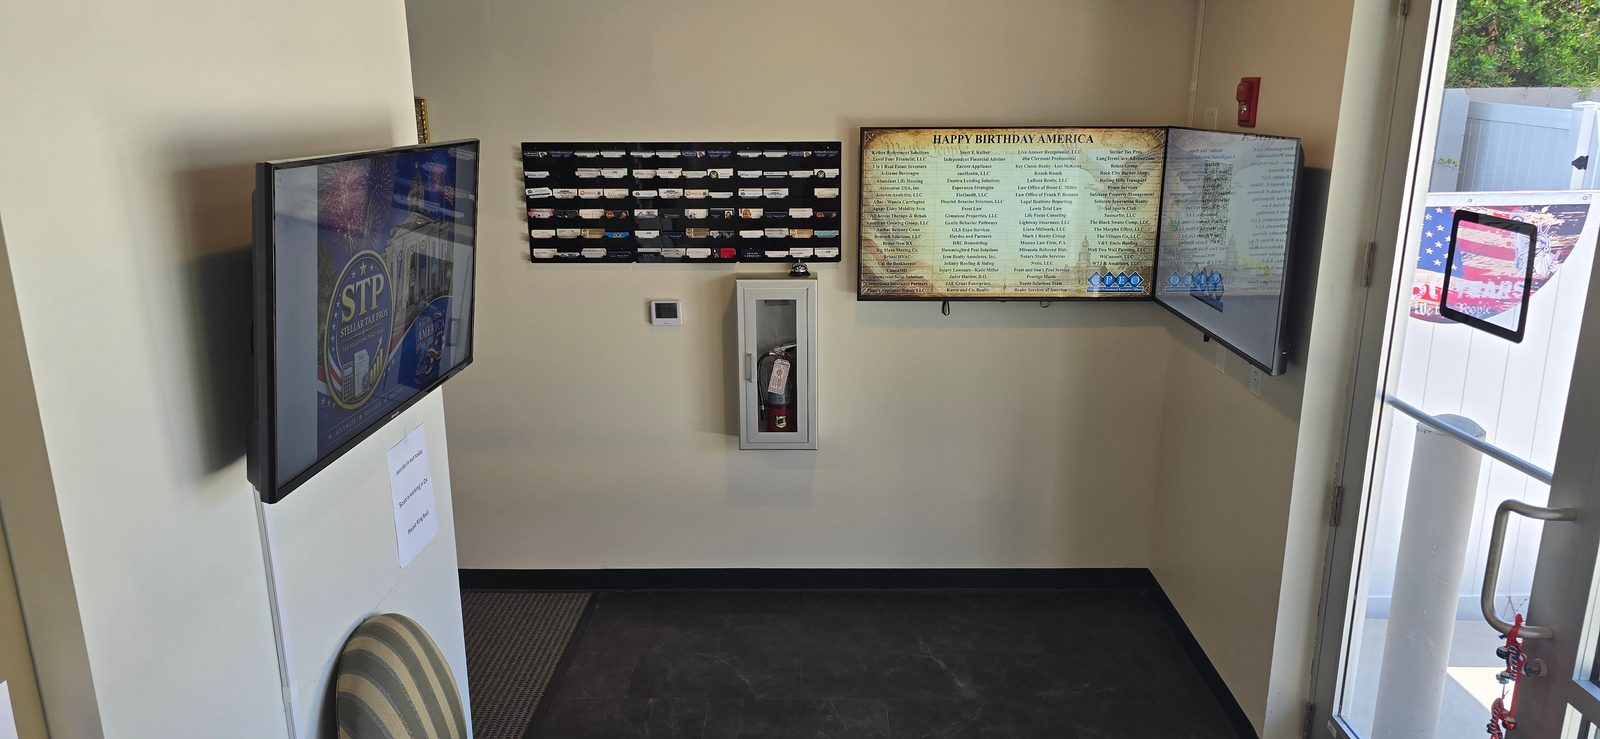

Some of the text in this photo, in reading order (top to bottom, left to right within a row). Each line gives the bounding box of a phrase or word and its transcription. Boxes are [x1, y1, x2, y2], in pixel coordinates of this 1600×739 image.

[933, 134, 1094, 144] HAPPY BIRTHDAY AMERICA
[1092, 276, 1140, 285] CPEO
[342, 274, 384, 322] STP
[340, 310, 388, 338] STELLAR TAX PROS
